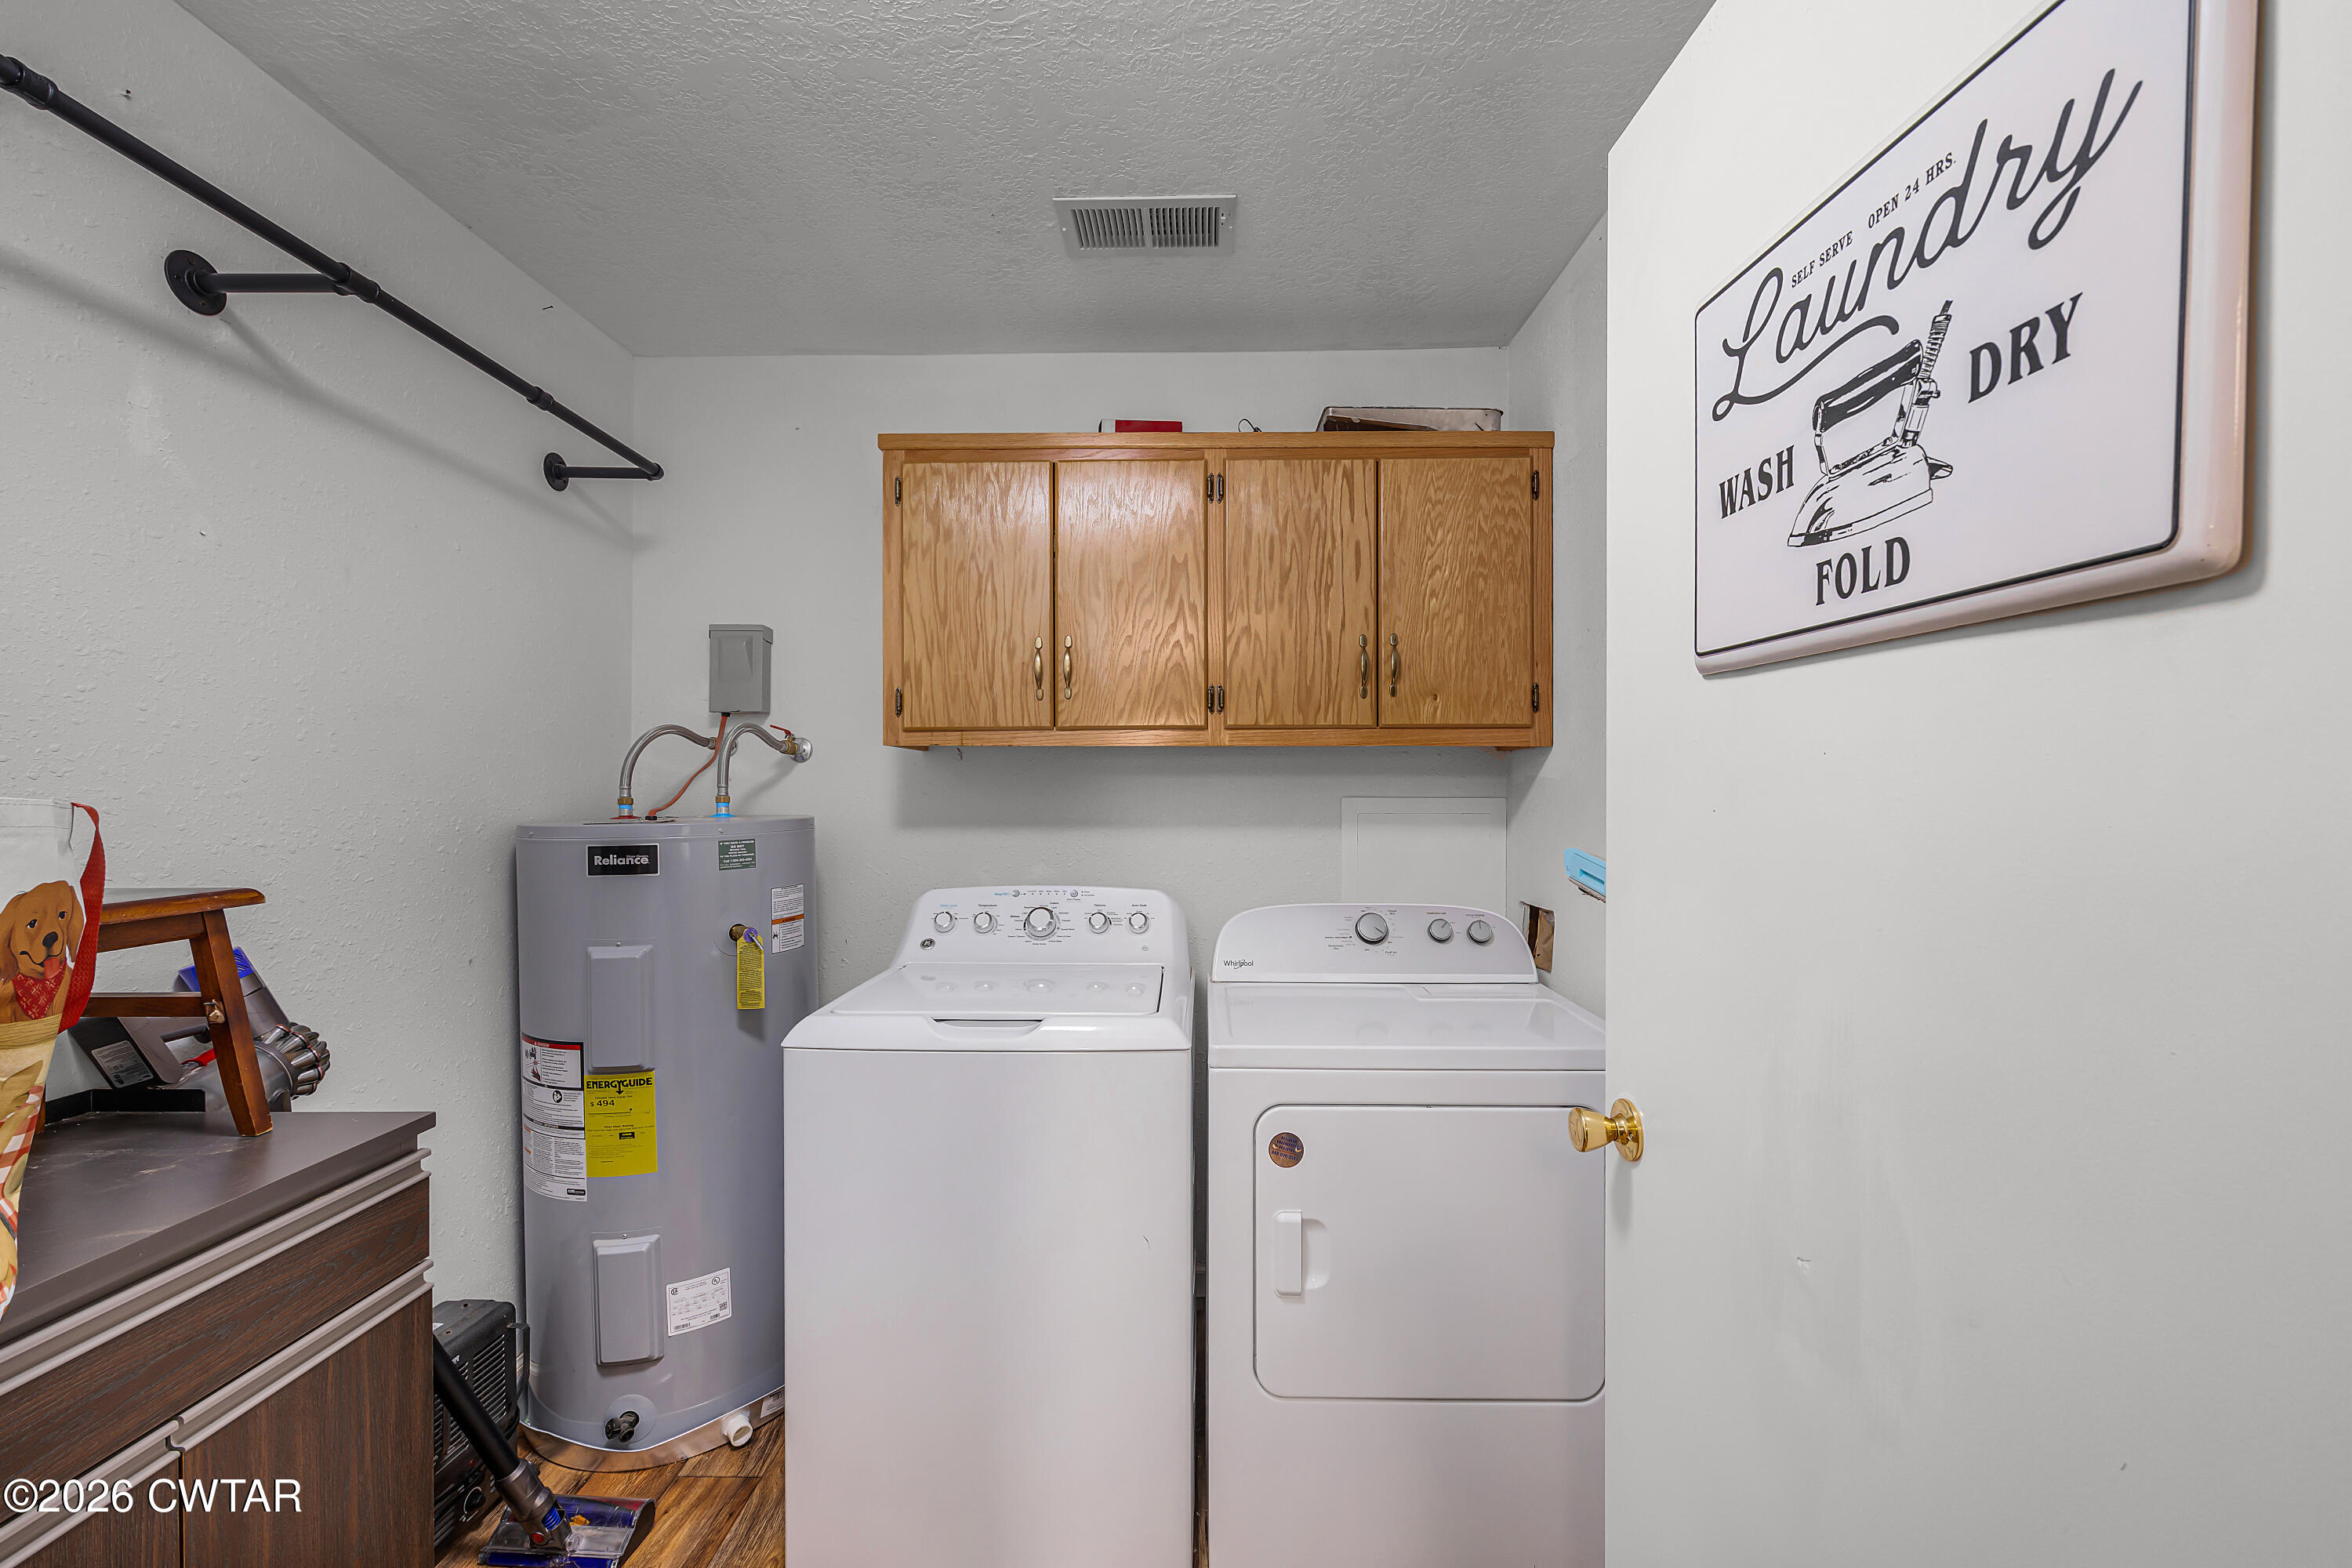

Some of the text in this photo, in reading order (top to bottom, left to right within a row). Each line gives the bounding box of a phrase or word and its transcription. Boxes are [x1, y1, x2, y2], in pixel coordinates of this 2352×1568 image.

[1867, 151, 1957, 229] OPEN 24 HRS.
[1711, 68, 2144, 422] Laundry
[1791, 230, 1853, 289] SELF SERVE
[1967, 292, 2083, 404] DRY
[1719, 444, 1795, 520] WASH
[1815, 536, 1911, 606] FOLD
[593, 854, 649, 866] Reliance
[1223, 959, 1254, 969] Whirlpool
[586, 1077, 653, 1091] ENERGYGUIDE
